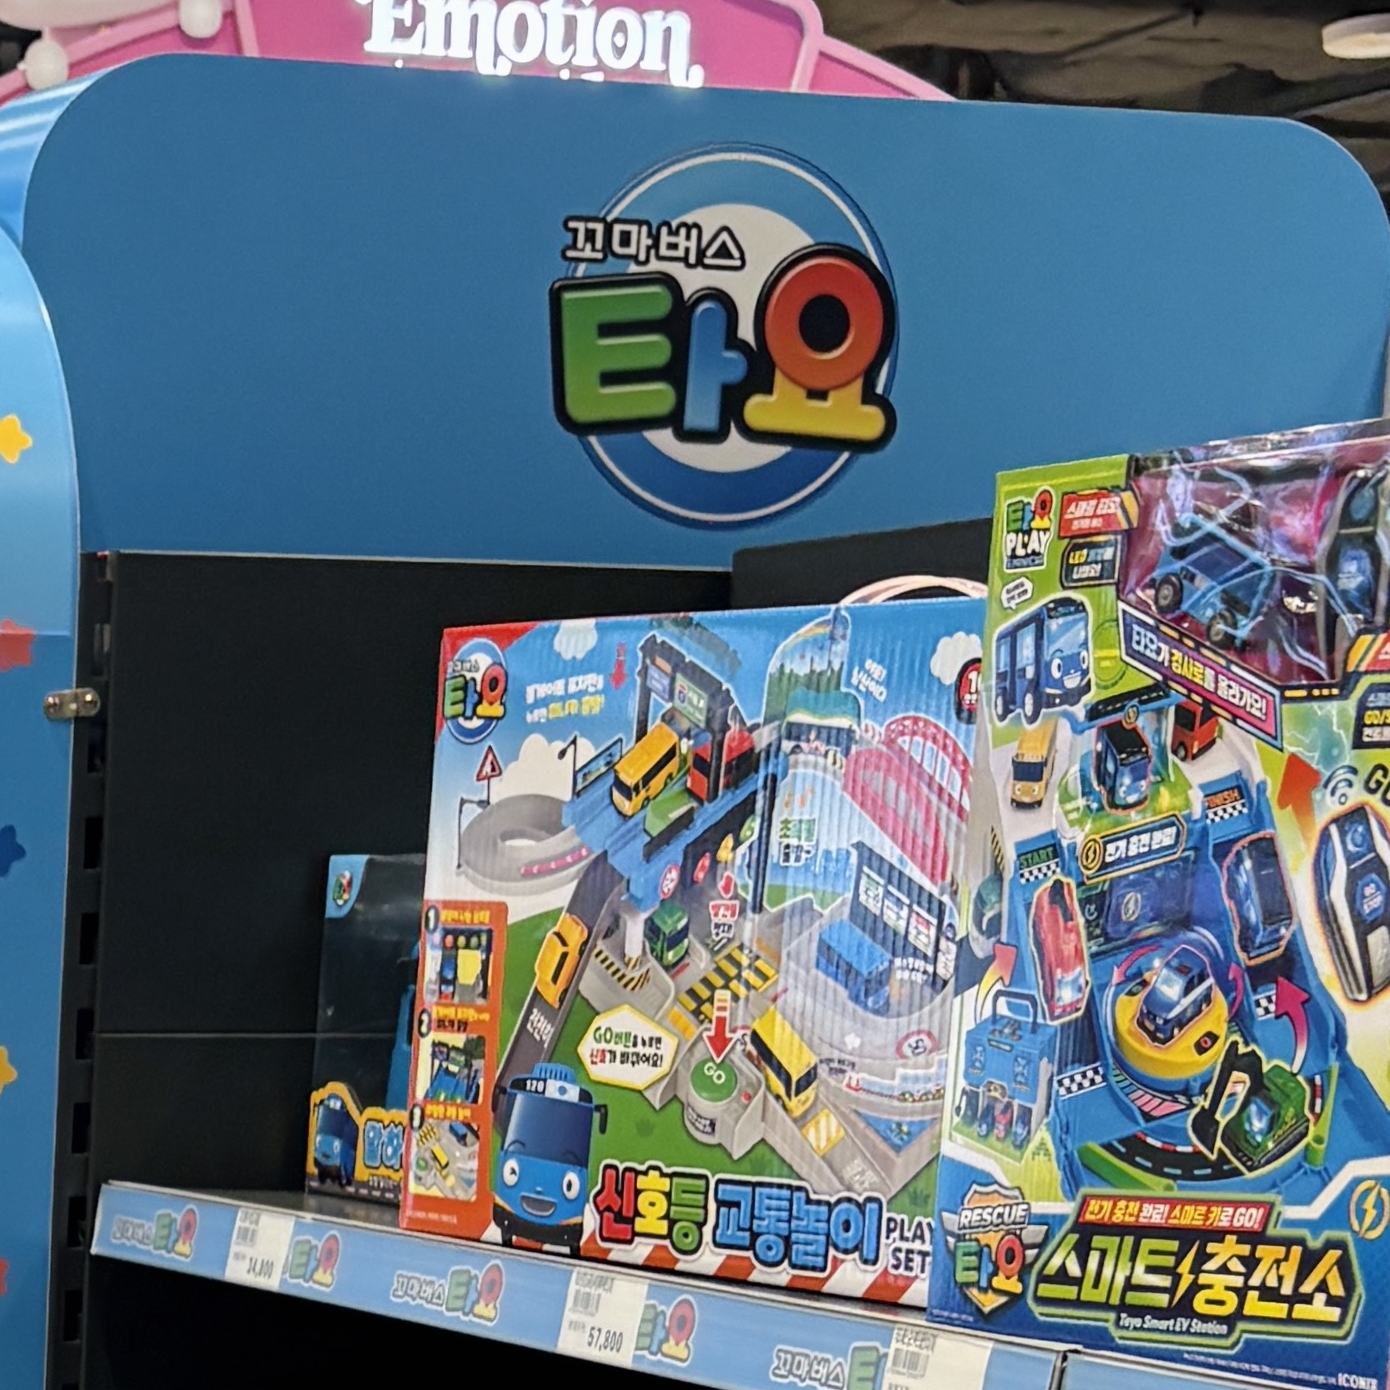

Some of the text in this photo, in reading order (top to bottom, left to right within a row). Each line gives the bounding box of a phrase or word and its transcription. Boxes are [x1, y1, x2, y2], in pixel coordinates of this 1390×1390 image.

[563, 215, 746, 272] 꼬마버스
[549, 243, 899, 454] 타요
[1005, 530, 1050, 557] PLAY
[443, 664, 508, 720] 타요
[703, 1062, 726, 1085] GO
[153, 1206, 199, 1259] 타요
[594, 1163, 885, 1273] 신호등 교통놀이
[885, 1217, 933, 1242] PLAY
[957, 1202, 1031, 1231] RESCUE
[289, 1233, 340, 1288] 타요
[891, 1248, 932, 1274] SET
[953, 1233, 1026, 1293] 타요
[1036, 1232, 1345, 1319] 스마트 충전소
[445, 1261, 503, 1324] 타요
[586, 1324, 624, 1354] 57,800
[635, 1295, 697, 1363] 타요
[773, 1346, 847, 1389] 꼬마버스
